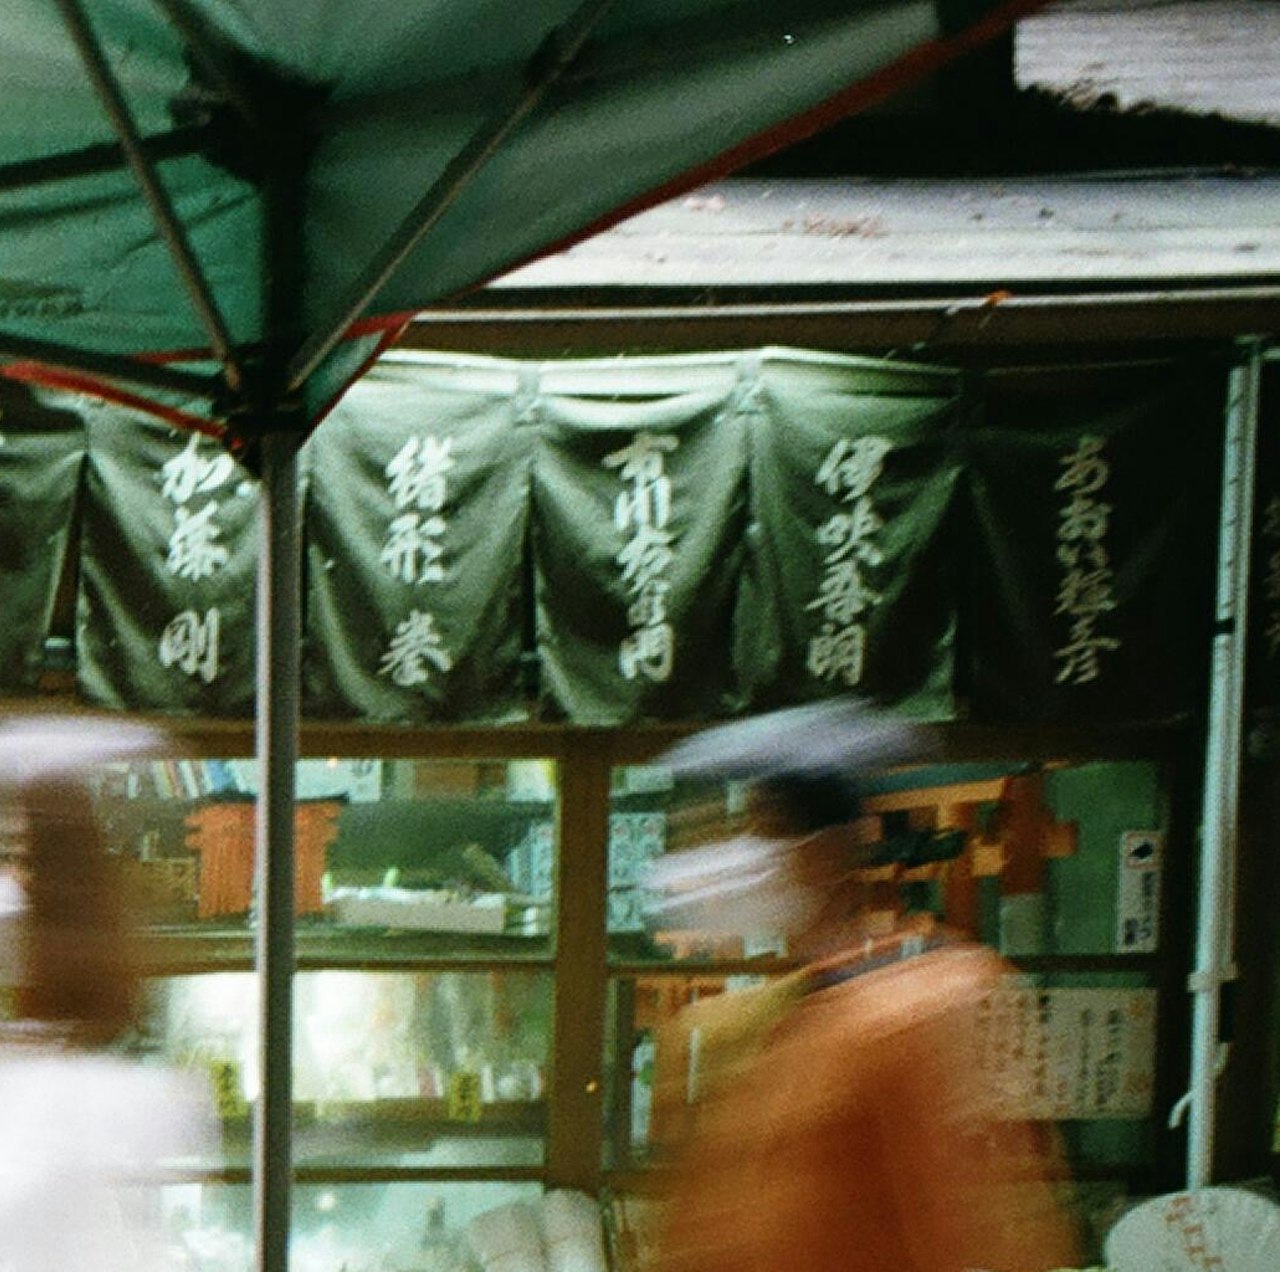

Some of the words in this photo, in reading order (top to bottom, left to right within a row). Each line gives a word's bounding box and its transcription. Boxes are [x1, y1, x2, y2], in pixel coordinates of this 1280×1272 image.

[1053, 440, 1119, 686] あおい輝彦
